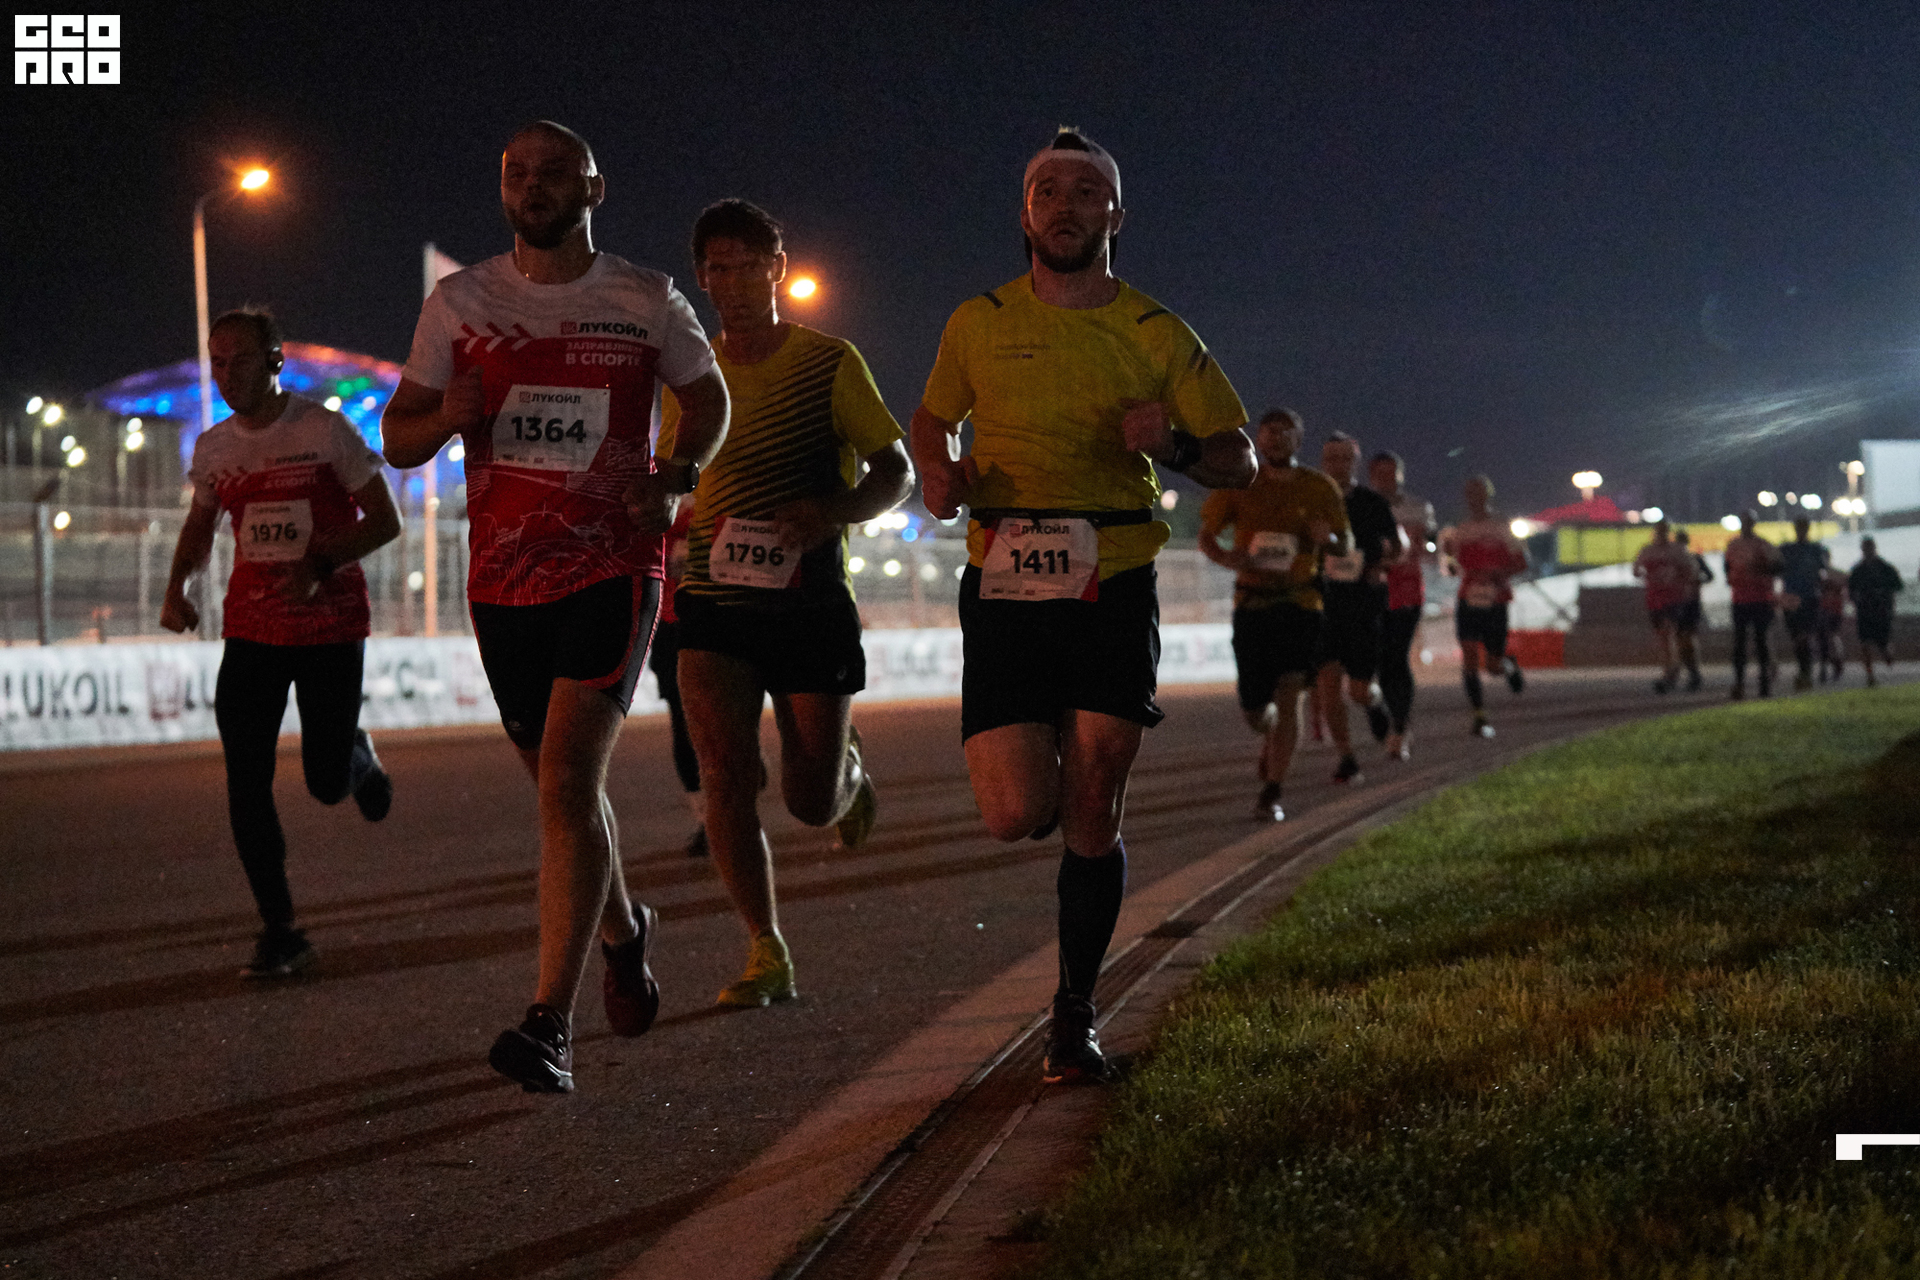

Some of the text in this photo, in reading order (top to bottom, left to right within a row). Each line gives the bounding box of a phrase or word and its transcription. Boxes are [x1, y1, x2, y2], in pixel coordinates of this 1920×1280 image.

[578, 321, 649, 340] ЛУКОЙЛ
[565, 353, 576, 365] В
[531, 393, 582, 404] ЛУКОЙЛ
[511, 416, 587, 443] 1364
[250, 522, 298, 544] 1976
[725, 542, 785, 566] 1796
[1010, 549, 1069, 574] 1411
